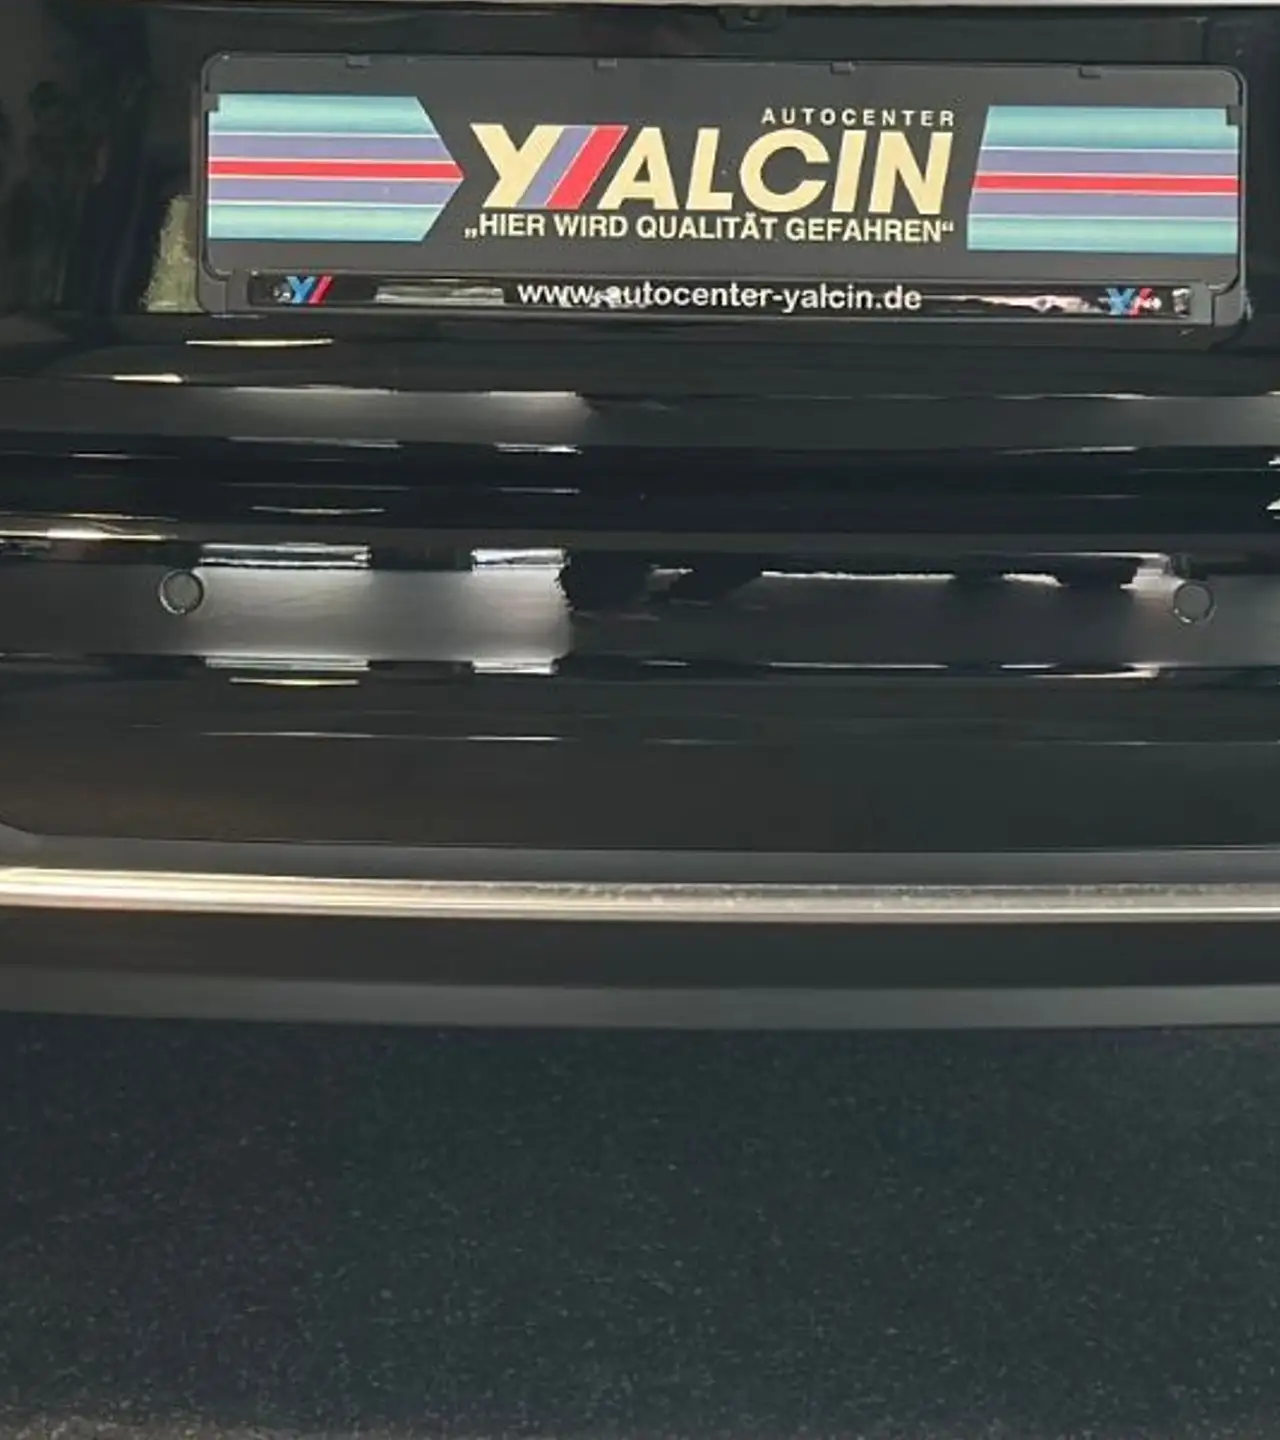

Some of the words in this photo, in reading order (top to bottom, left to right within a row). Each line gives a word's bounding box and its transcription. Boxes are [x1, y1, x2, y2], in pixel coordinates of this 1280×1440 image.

[760, 107, 955, 127] AUTOCENTER
[552, 215, 628, 238] WIRD
[635, 212, 779, 240] QUALITÄT
[517, 281, 922, 314] www.autocenter-yalcin.de
